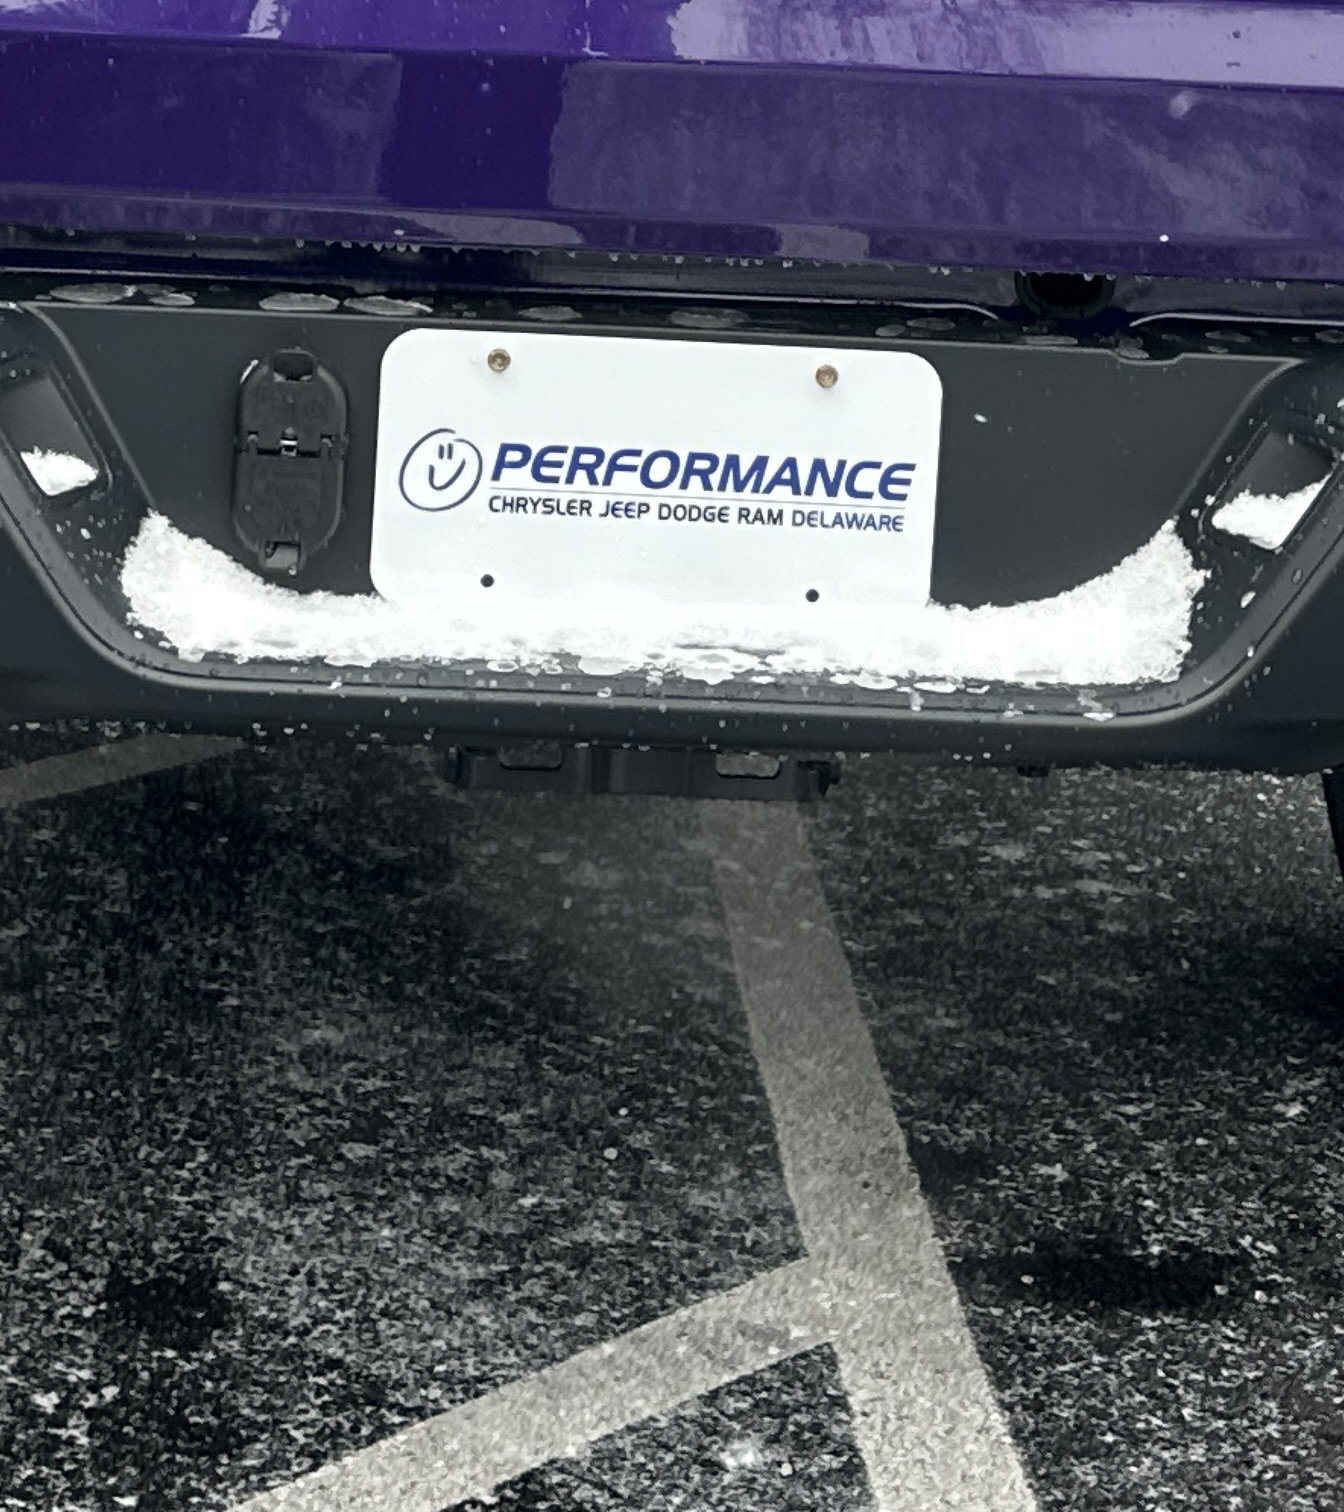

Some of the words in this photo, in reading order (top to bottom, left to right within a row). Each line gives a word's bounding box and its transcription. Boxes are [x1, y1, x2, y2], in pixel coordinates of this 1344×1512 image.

[491, 442, 916, 501] PERFORMANCE
[488, 495, 592, 517] CHRYSLER
[599, 500, 651, 519] JEEP
[658, 502, 730, 523] DODGE
[737, 506, 783, 526] RAM
[791, 509, 904, 532] DELAWARE
